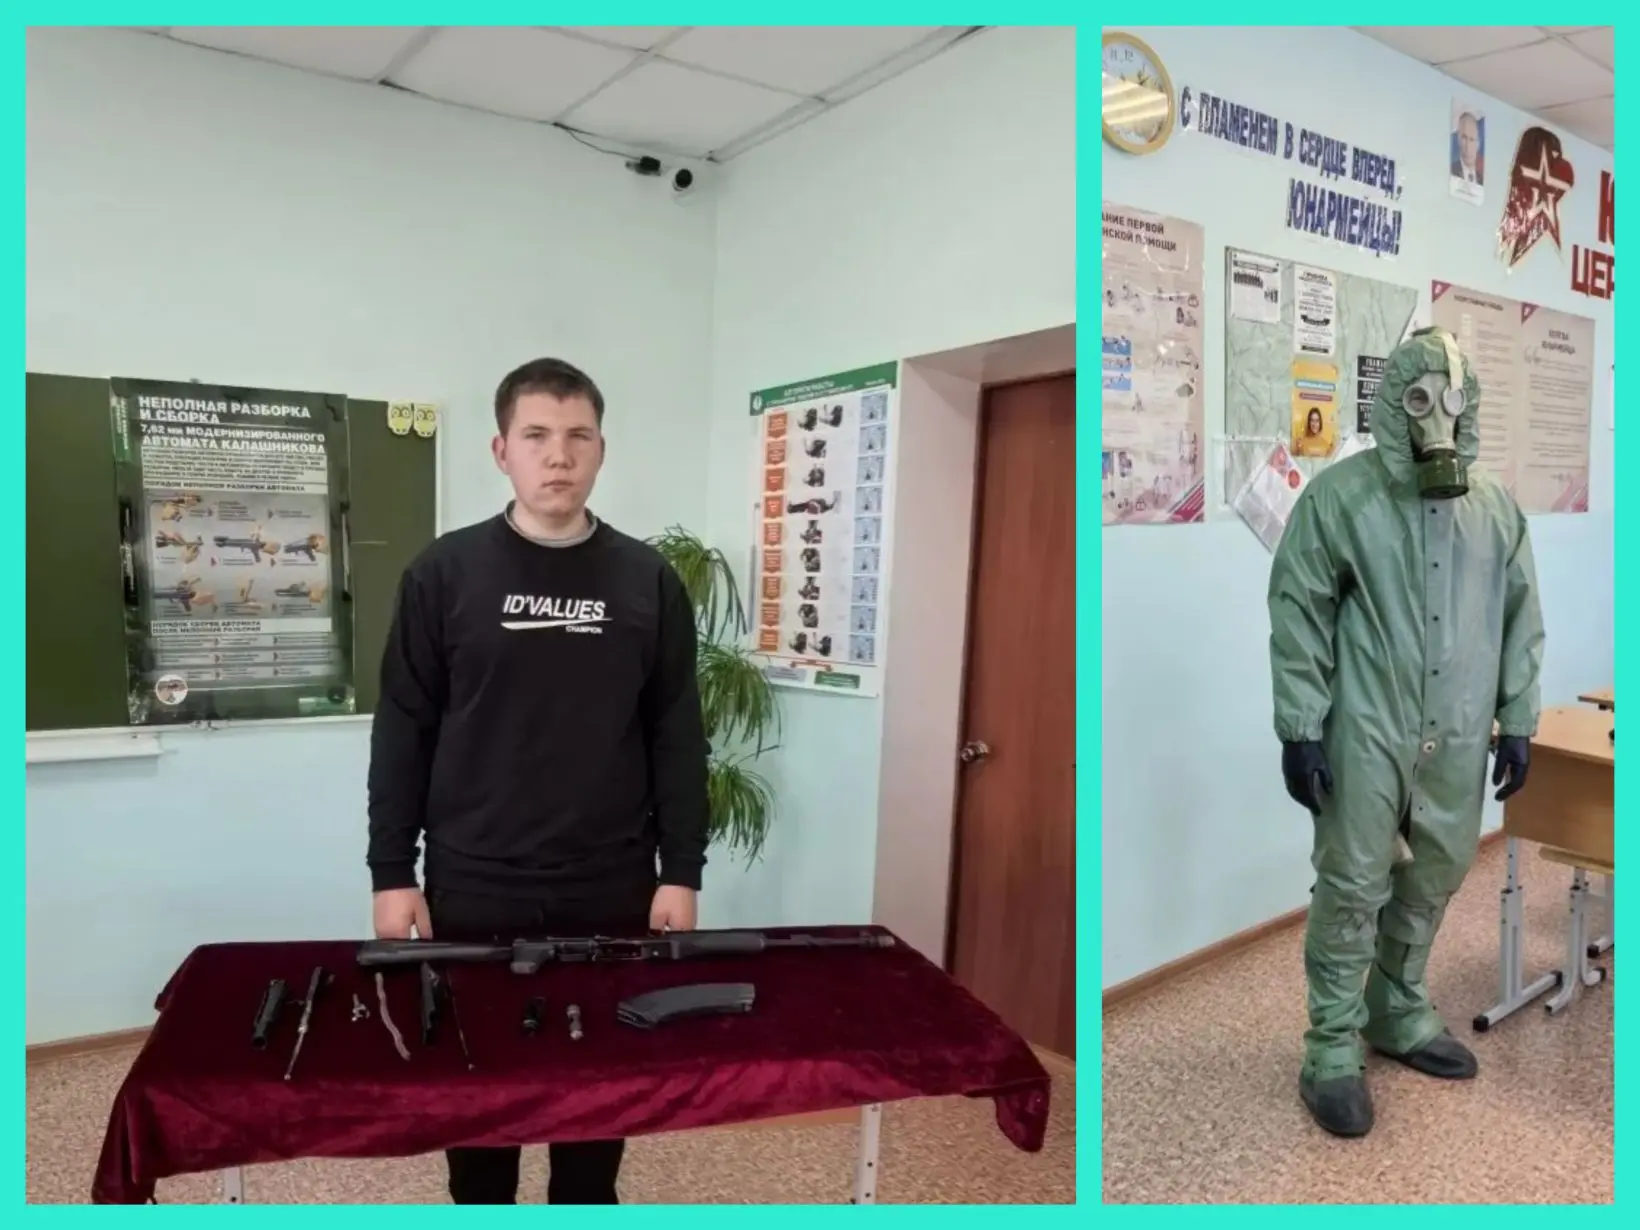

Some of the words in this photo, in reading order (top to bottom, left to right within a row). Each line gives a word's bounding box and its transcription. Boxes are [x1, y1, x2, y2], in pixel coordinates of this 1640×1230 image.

[1180, 86, 1191, 128] С
[1198, 92, 1278, 156] ПЛАМЕНЕМ
[1284, 122, 1294, 160] В
[1300, 129, 1348, 181] СЕРДЦЕ
[1127, 217, 1164, 235] ПЕРВОЙ
[1287, 178, 1402, 257] ЮНАРМЕЙЦЫ!
[138, 396, 227, 413] НЕПОЛНАЯ
[231, 402, 312, 418] РАЗБОРКА
[140, 409, 151, 420] И
[156, 410, 220, 425] СБОРКА
[140, 424, 165, 434] 7,62
[186, 426, 325, 443] МОДЕРНИЗИРОВАННОГО
[142, 435, 218, 449] АВТОМАТА
[221, 439, 326, 454] КАЛАШНИКОВА
[565, 625, 603, 634] CHAMPION
